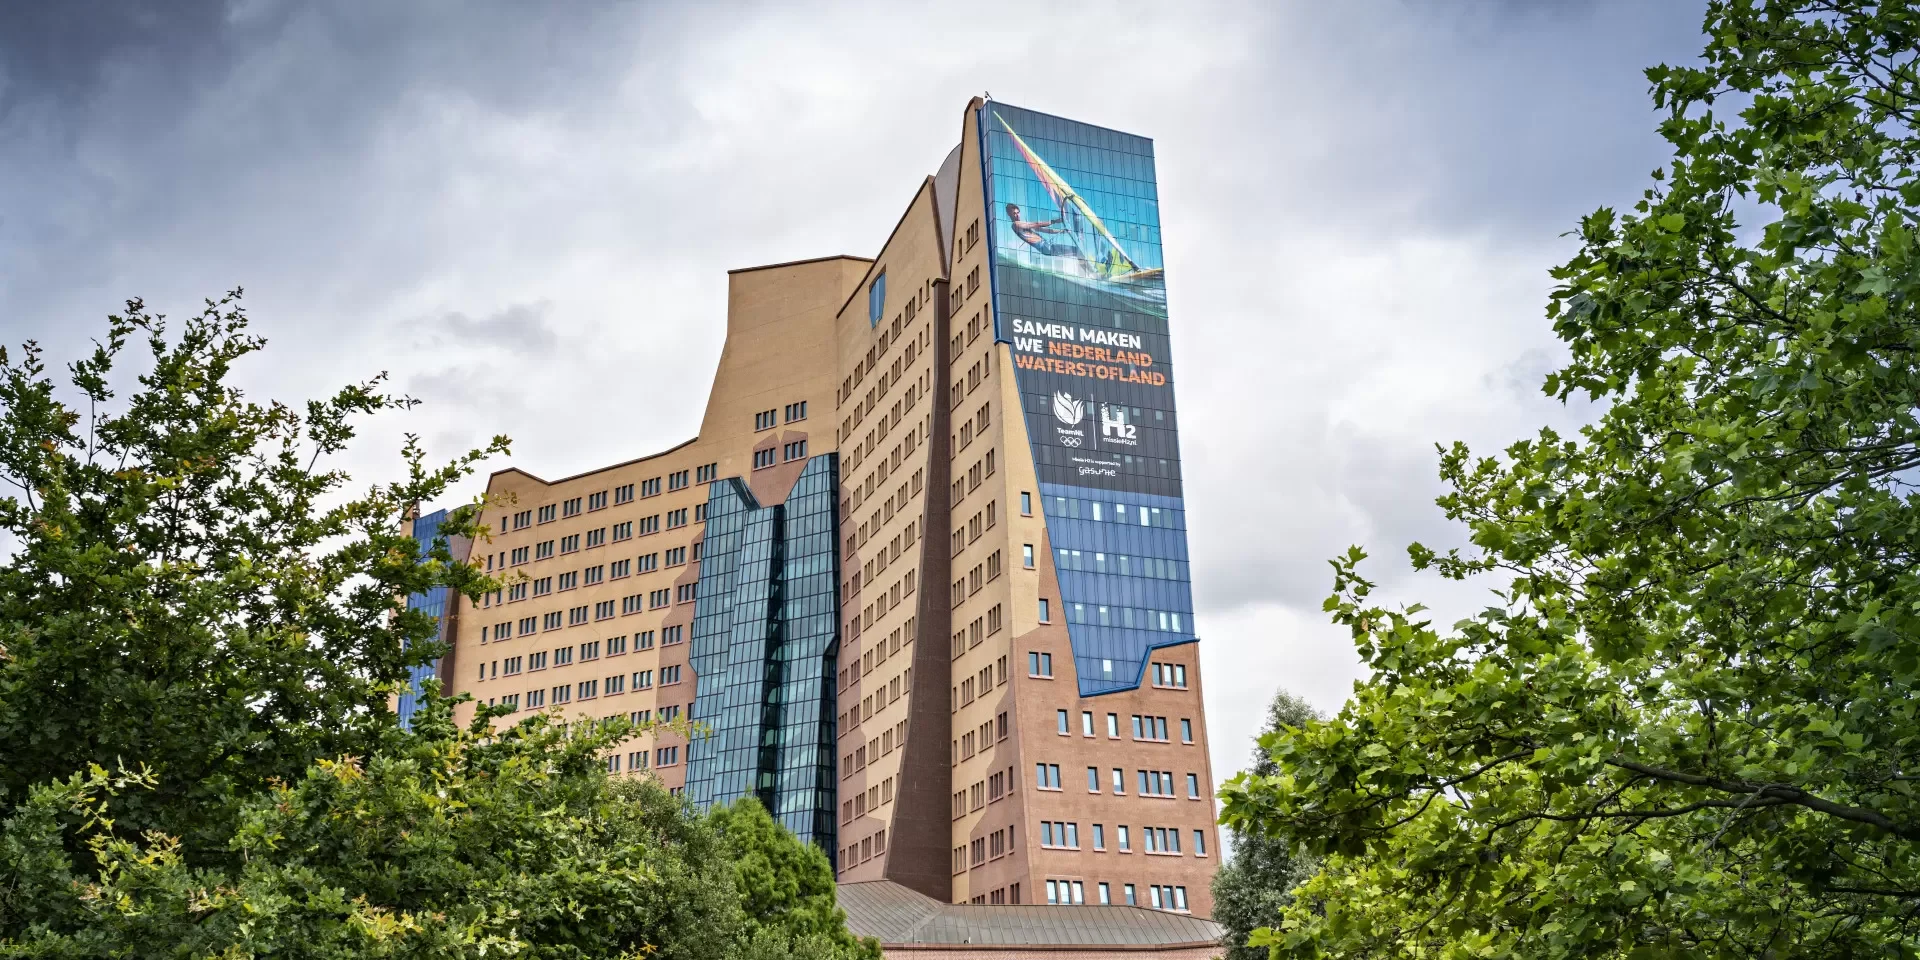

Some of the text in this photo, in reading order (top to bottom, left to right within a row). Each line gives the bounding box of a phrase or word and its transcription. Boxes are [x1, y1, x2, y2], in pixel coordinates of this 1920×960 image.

[1012, 319, 1142, 350] SAMEN MAKEN
[1014, 336, 1153, 368] WE NEDERLAND
[1015, 354, 1166, 387] WATERSTOFLAND
[1056, 428, 1084, 436] TeamNL
[1101, 402, 1137, 439] H2
